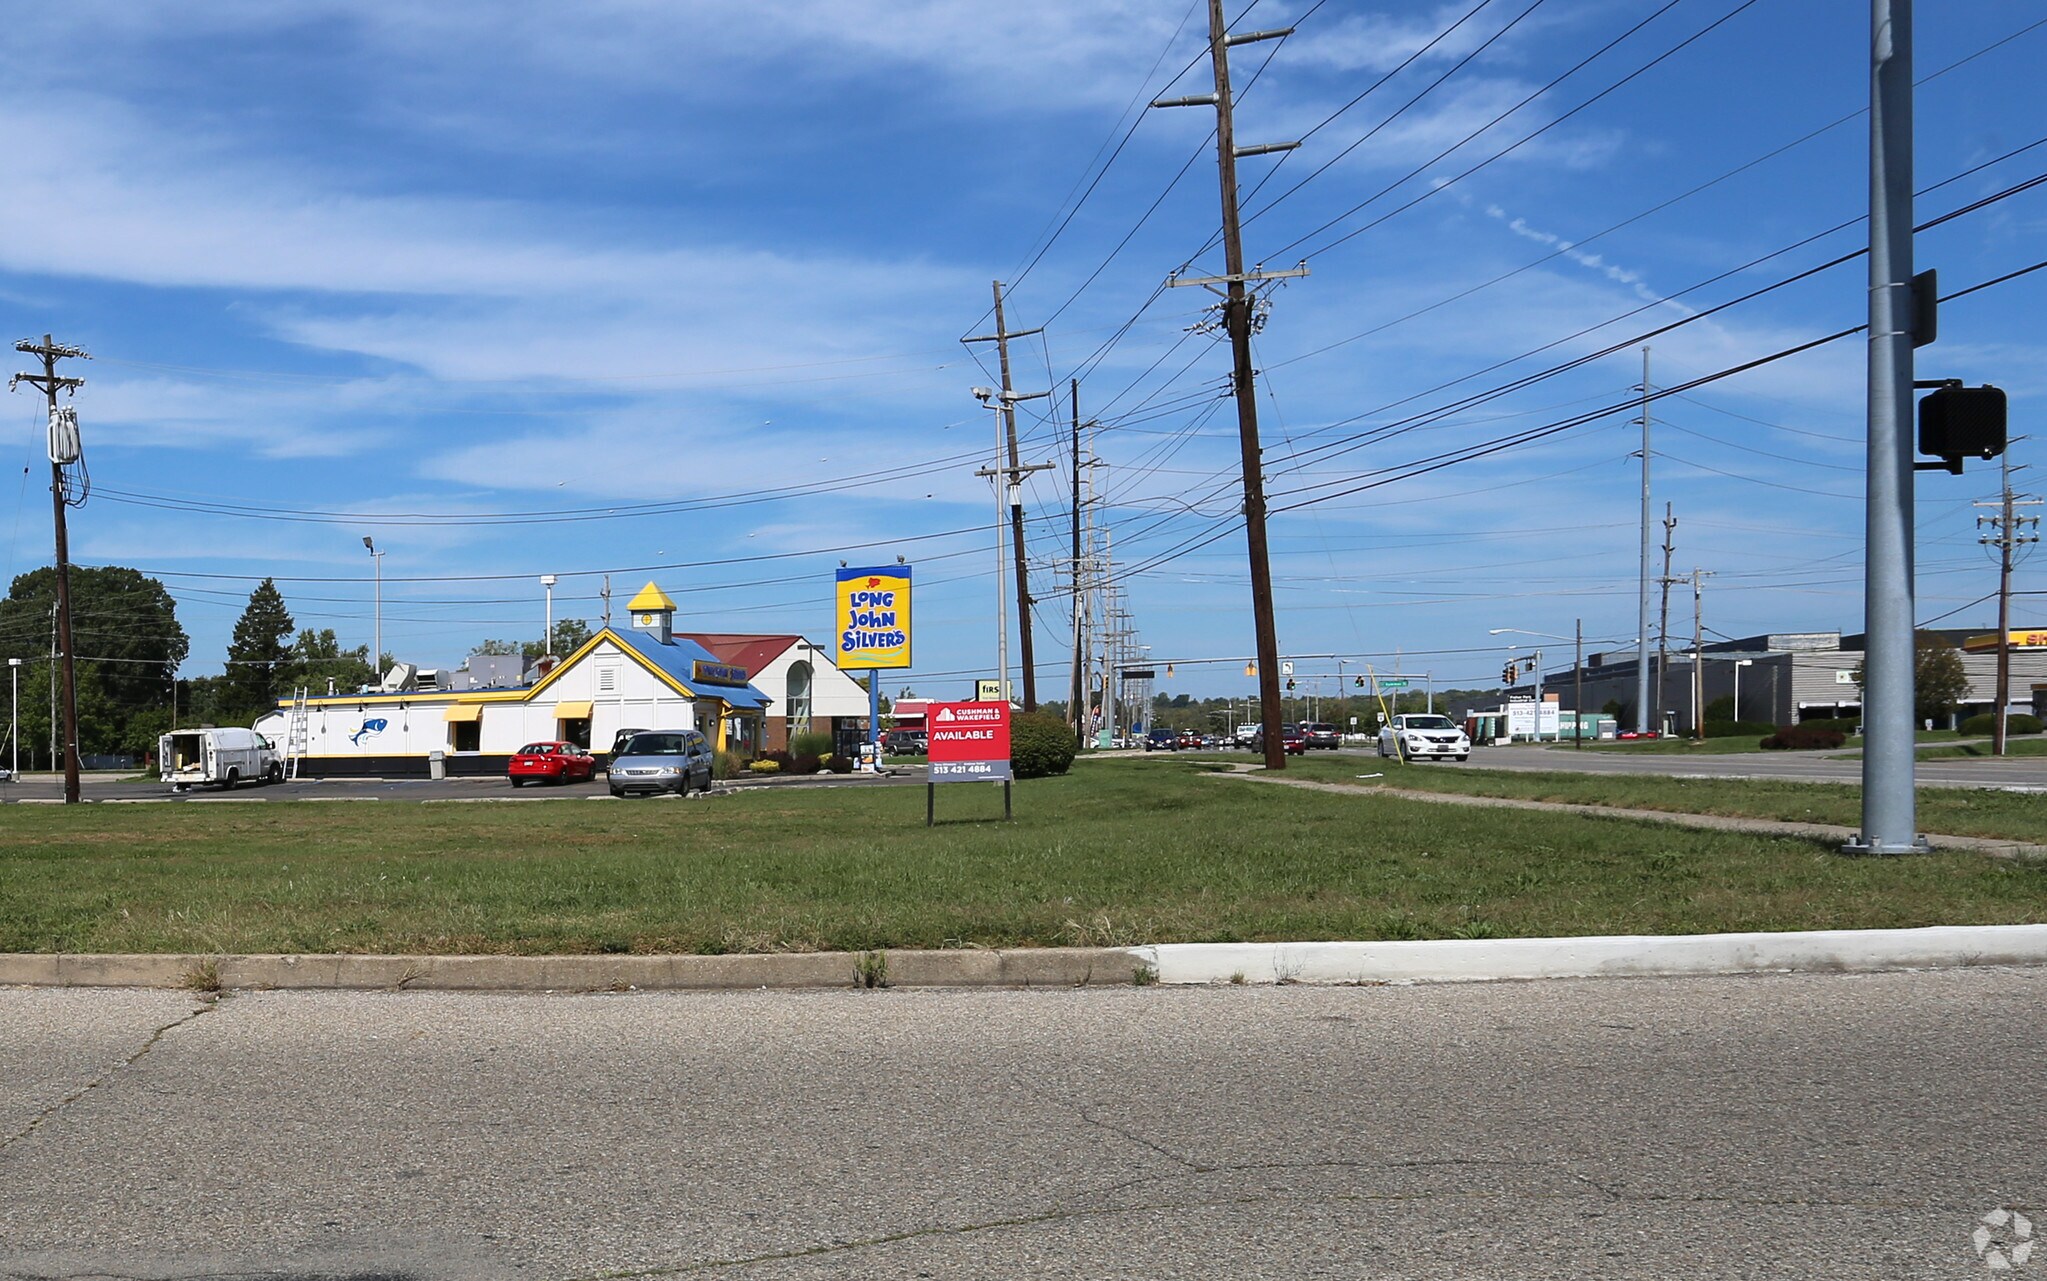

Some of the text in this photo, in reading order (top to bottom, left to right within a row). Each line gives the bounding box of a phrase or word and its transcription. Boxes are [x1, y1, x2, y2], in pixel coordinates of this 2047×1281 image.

[850, 591, 895, 608] LONG
[933, 730, 994, 740] AVAILABLE
[933, 765, 991, 774] 513 421 4884
